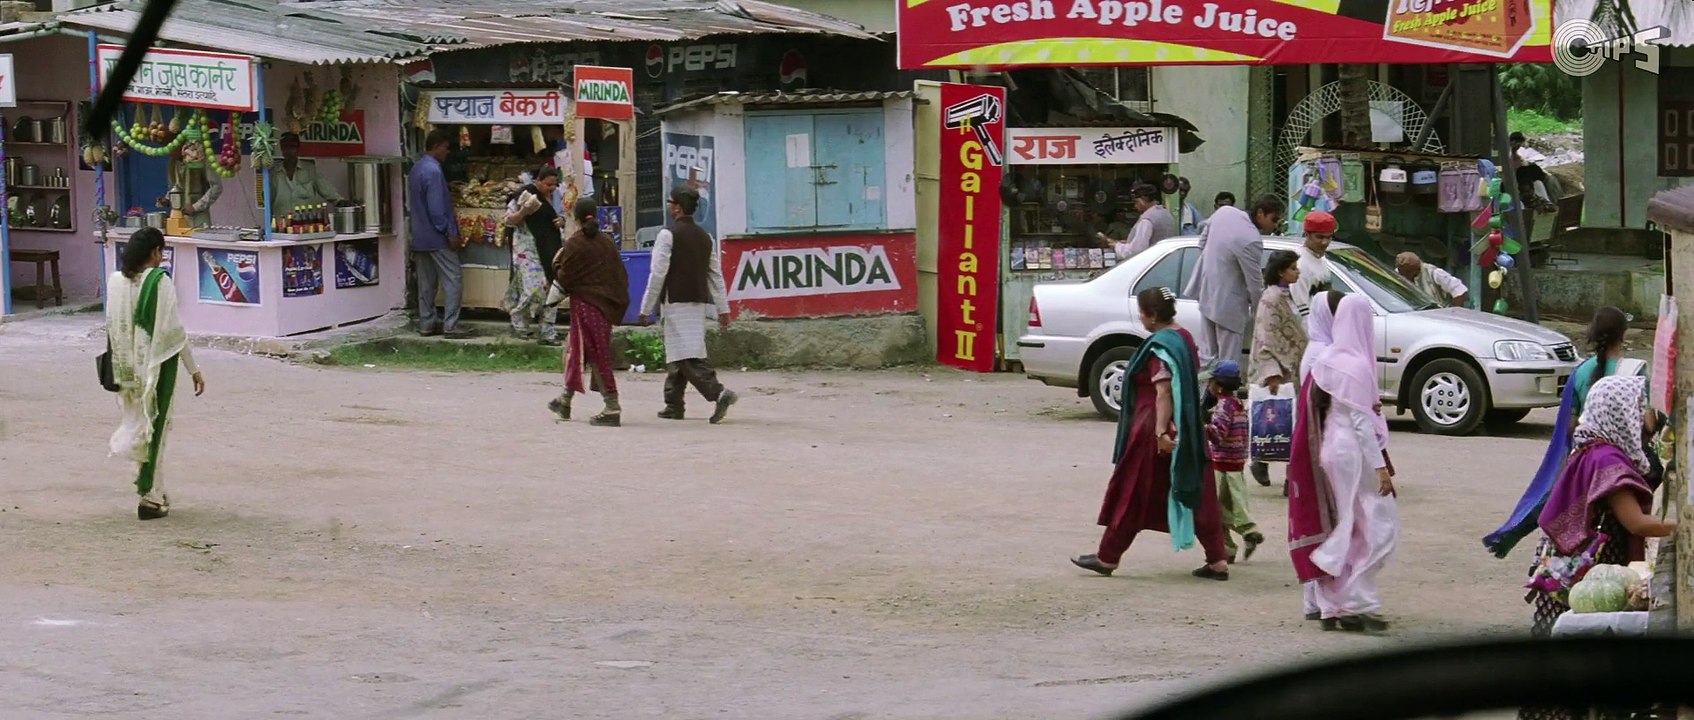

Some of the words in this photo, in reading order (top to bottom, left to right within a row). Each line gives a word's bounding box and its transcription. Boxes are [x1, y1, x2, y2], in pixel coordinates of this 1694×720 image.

[946, 0, 1056, 32] Fresh
[1066, 0, 1184, 27] Apple
[1193, 3, 1297, 41] Juice
[1424, 8, 1458, 27] Apple
[1459, 0, 1498, 17] Juice
[667, 43, 738, 73] PEPSI
[156, 61, 187, 88] जूस
[188, 61, 237, 92] कार्नर
[500, 91, 561, 117] बेकरी
[578, 82, 629, 102] MIRINDA
[1012, 135, 1082, 160] राज
[665, 143, 713, 183] PEPSI
[957, 140, 983, 326] Gallant
[226, 253, 257, 265] PEPSI
[737, 251, 892, 291] MIRINDA
